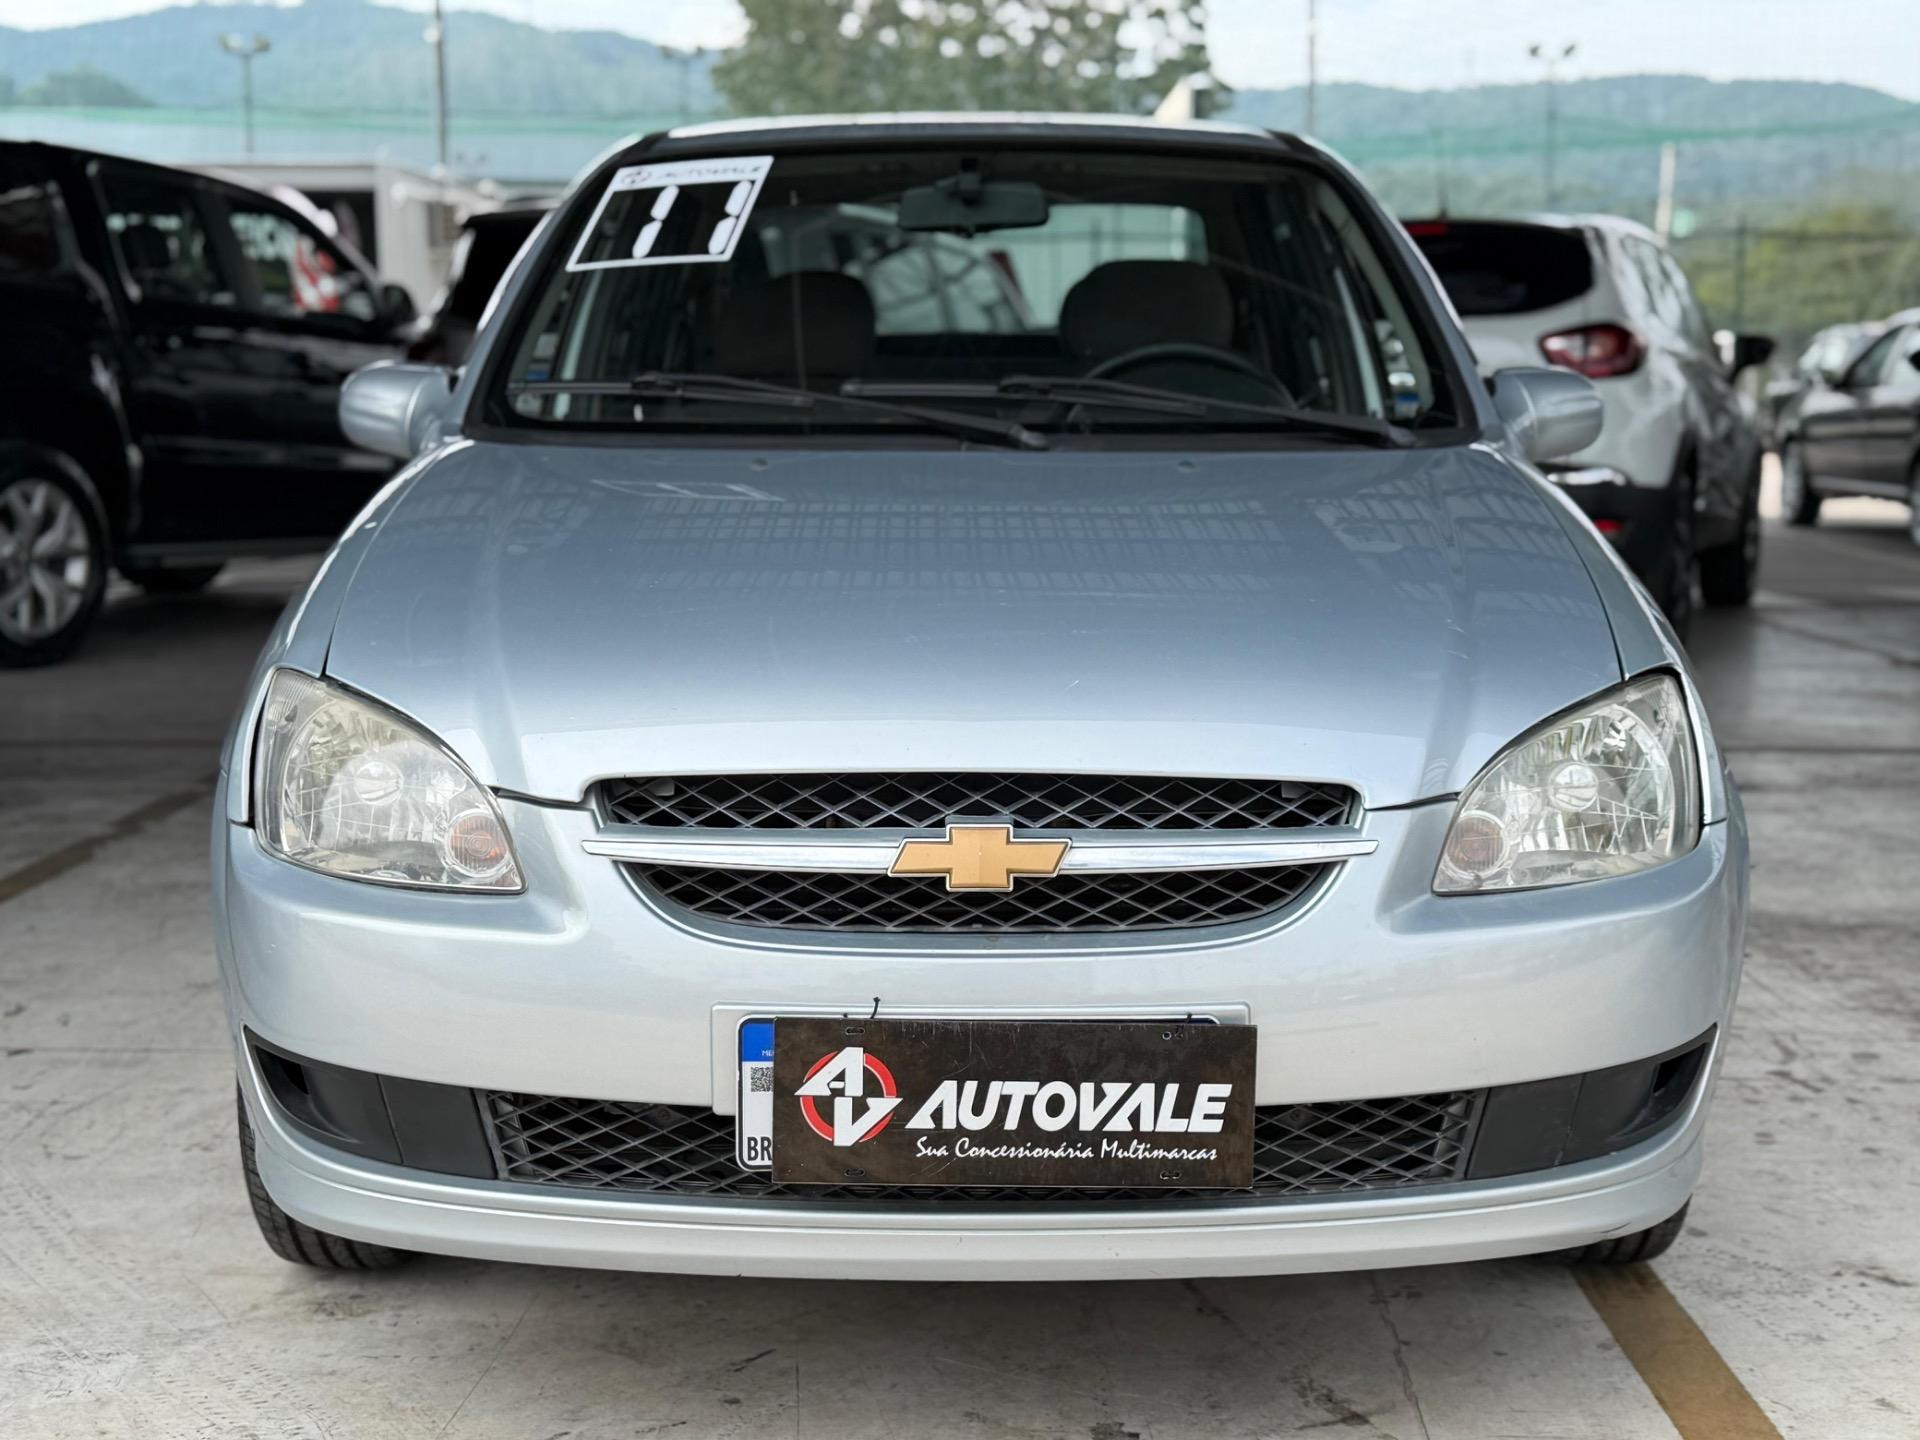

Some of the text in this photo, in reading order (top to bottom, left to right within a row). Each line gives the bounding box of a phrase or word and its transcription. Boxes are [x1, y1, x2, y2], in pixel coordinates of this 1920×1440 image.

[904, 1080, 1233, 1133] AUTOVALE
[916, 1135, 1218, 1161] Sua Concessionária Multimarcas
